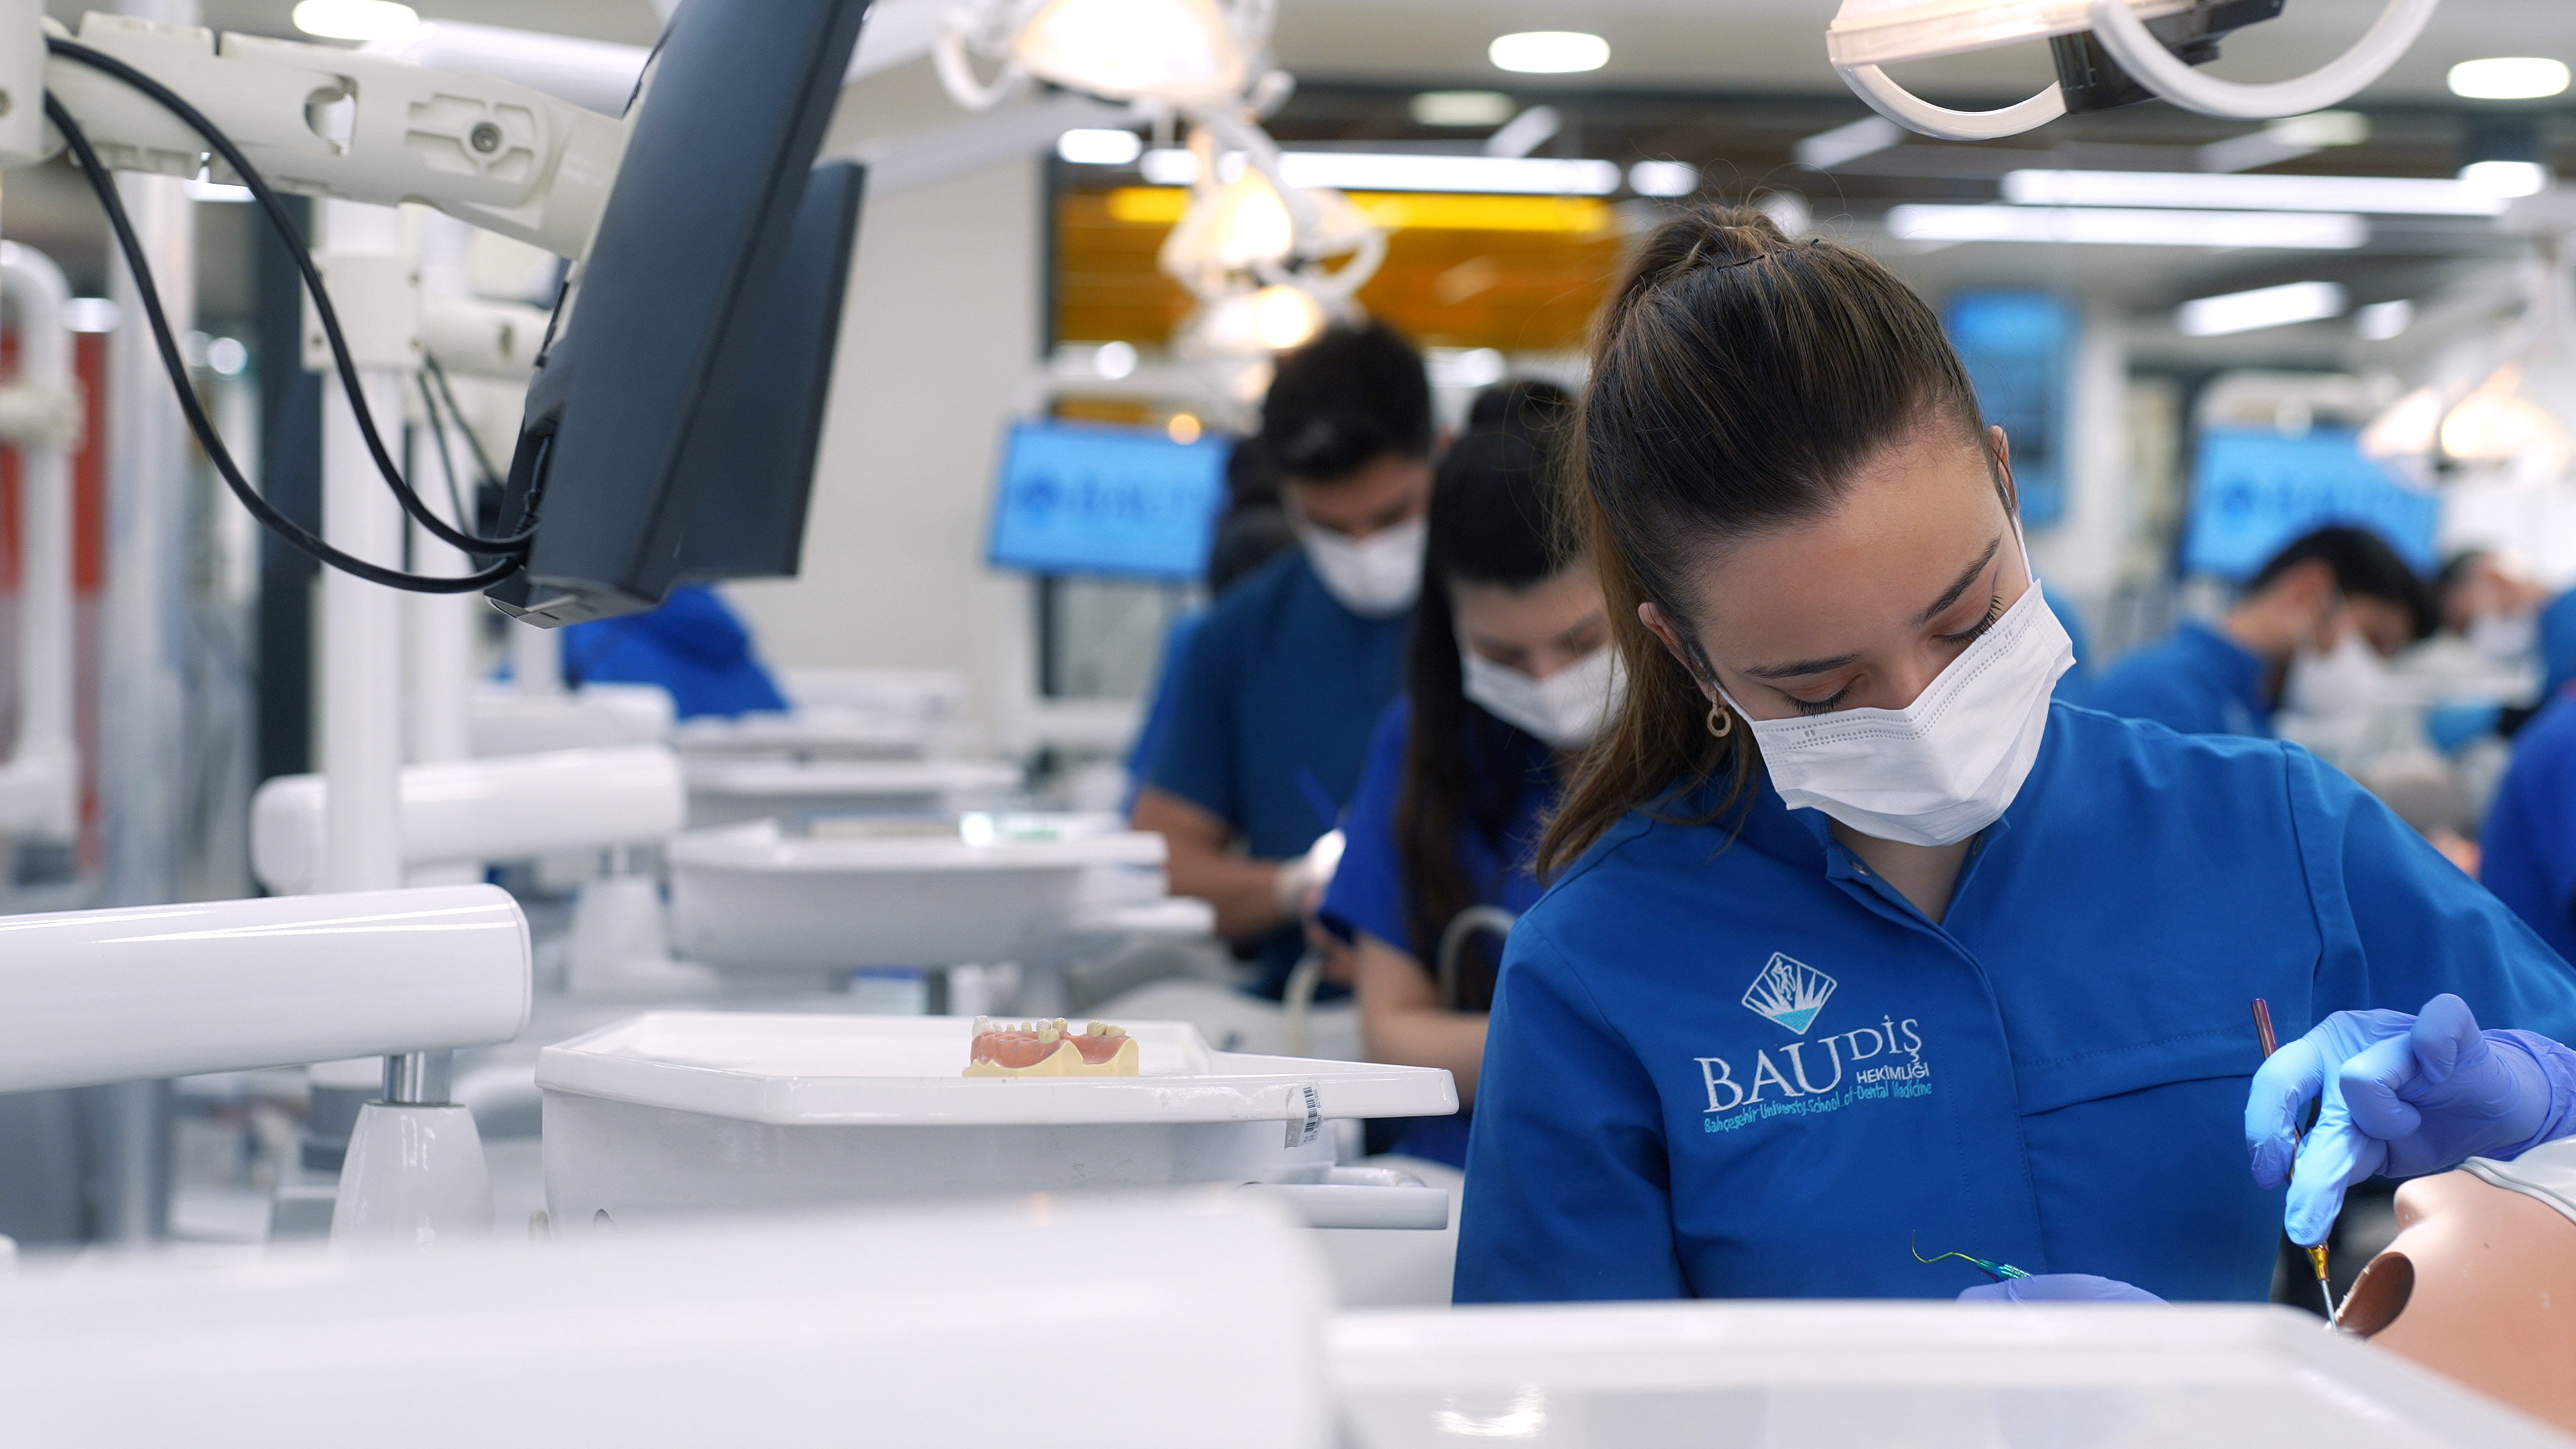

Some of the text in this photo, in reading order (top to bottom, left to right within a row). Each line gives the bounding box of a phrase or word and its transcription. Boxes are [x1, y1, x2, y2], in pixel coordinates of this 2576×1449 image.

[1693, 1014, 1922, 1112] BAU DİŞ
[1808, 1093, 1840, 1112] School
[1844, 1087, 1853, 1106] of
[1858, 1081, 1888, 1099] Dental
[1892, 1079, 1931, 1099] Medicine
